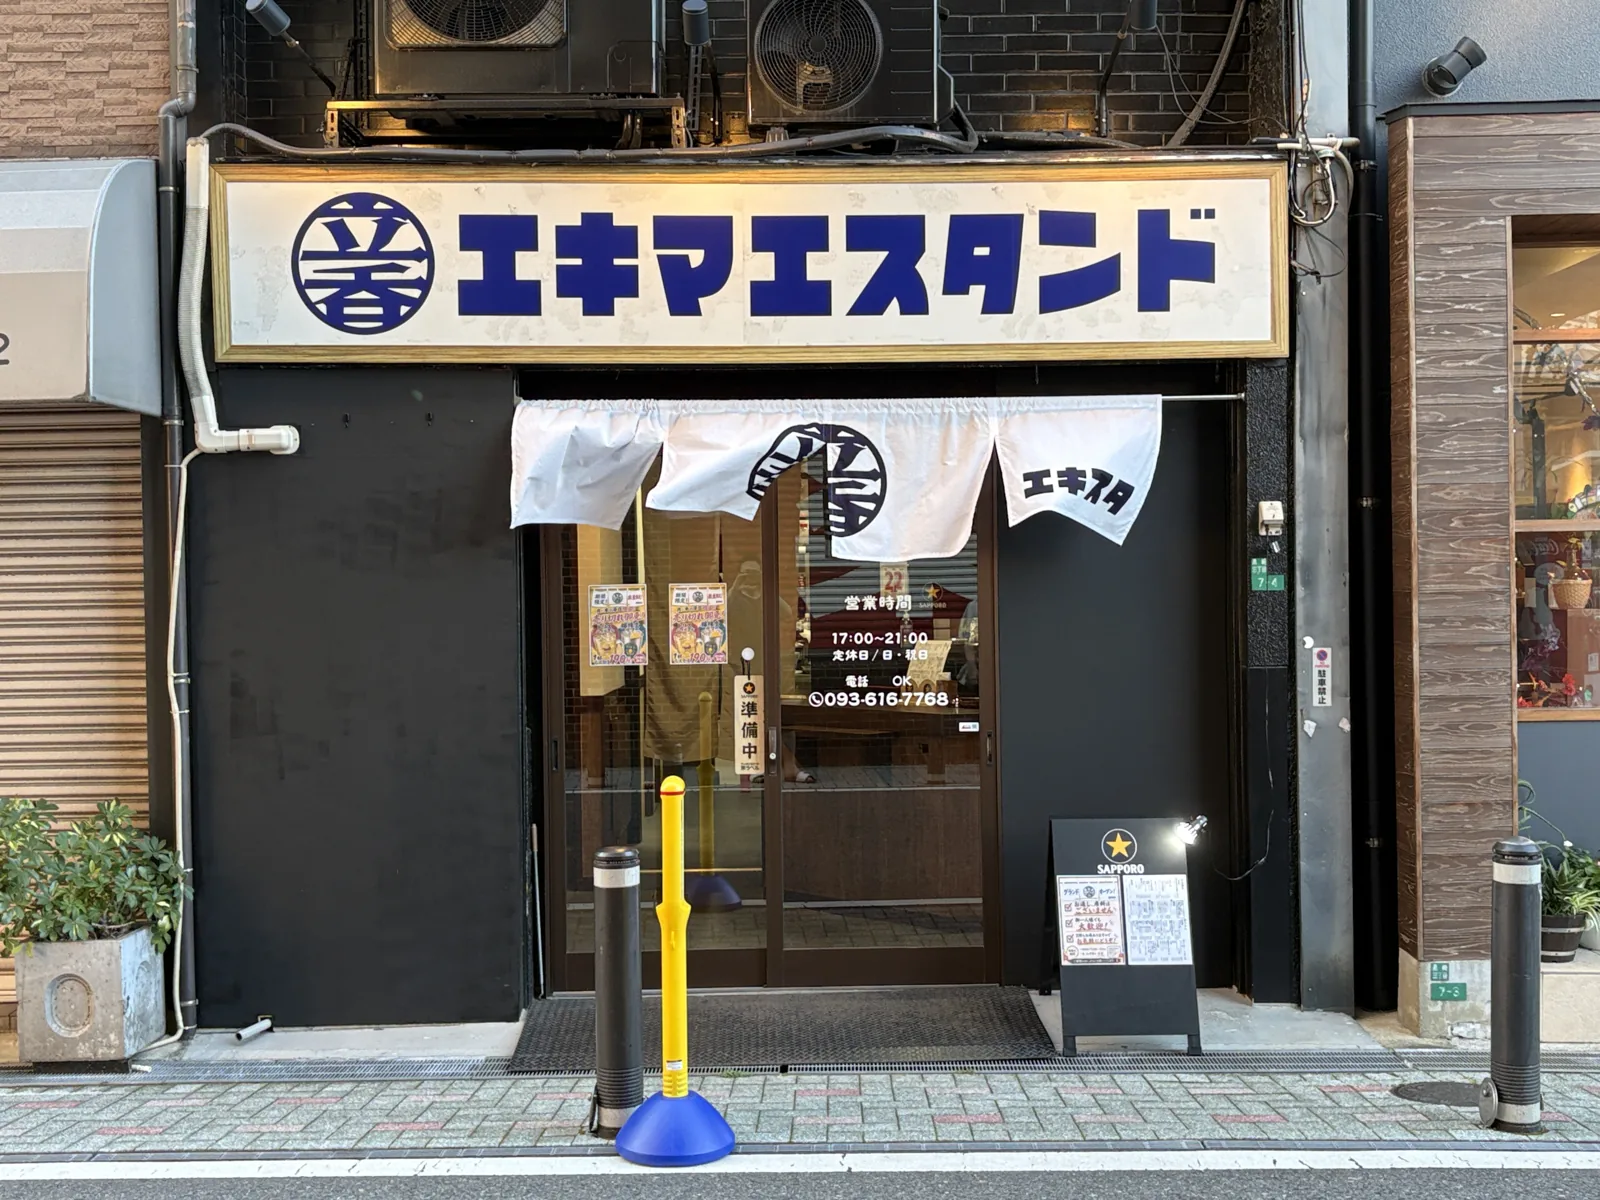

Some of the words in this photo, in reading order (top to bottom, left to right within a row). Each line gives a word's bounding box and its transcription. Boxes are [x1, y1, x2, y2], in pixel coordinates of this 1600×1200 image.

[458, 208, 1216, 317] エキマエスタンド
[1023, 466, 1136, 516] エキスタ
[844, 595, 912, 611] 営業時間
[845, 676, 869, 688] 電話
[892, 676, 912, 687] OK
[1317, 669, 1327, 705] 駐車禁止
[824, 692, 949, 707] 093-616-7768
[741, 701, 758, 760] 準備中
[1097, 864, 1145, 875] SAPPORO
